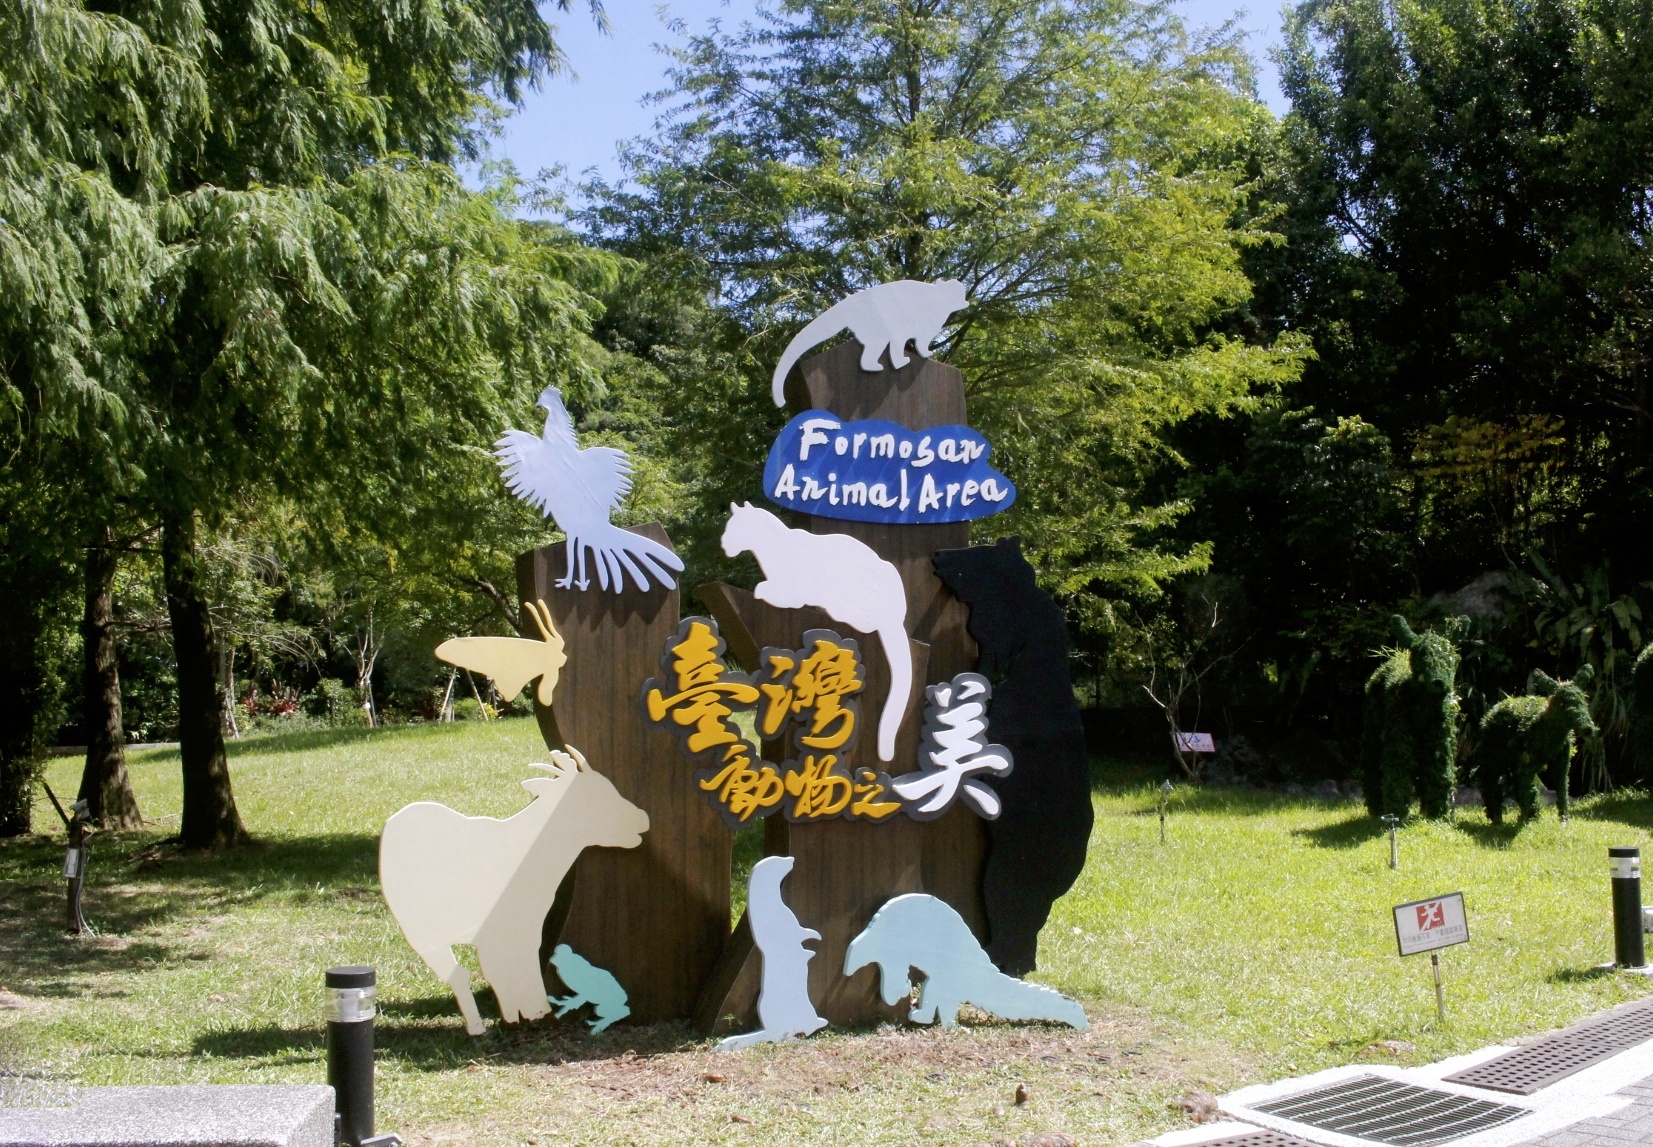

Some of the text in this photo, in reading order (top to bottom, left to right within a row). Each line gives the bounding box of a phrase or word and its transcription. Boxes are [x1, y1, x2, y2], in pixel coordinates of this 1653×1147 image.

[798, 418, 986, 468] Formosan
[774, 463, 1008, 513] Animal Area
[647, 621, 863, 753] 臺灣
